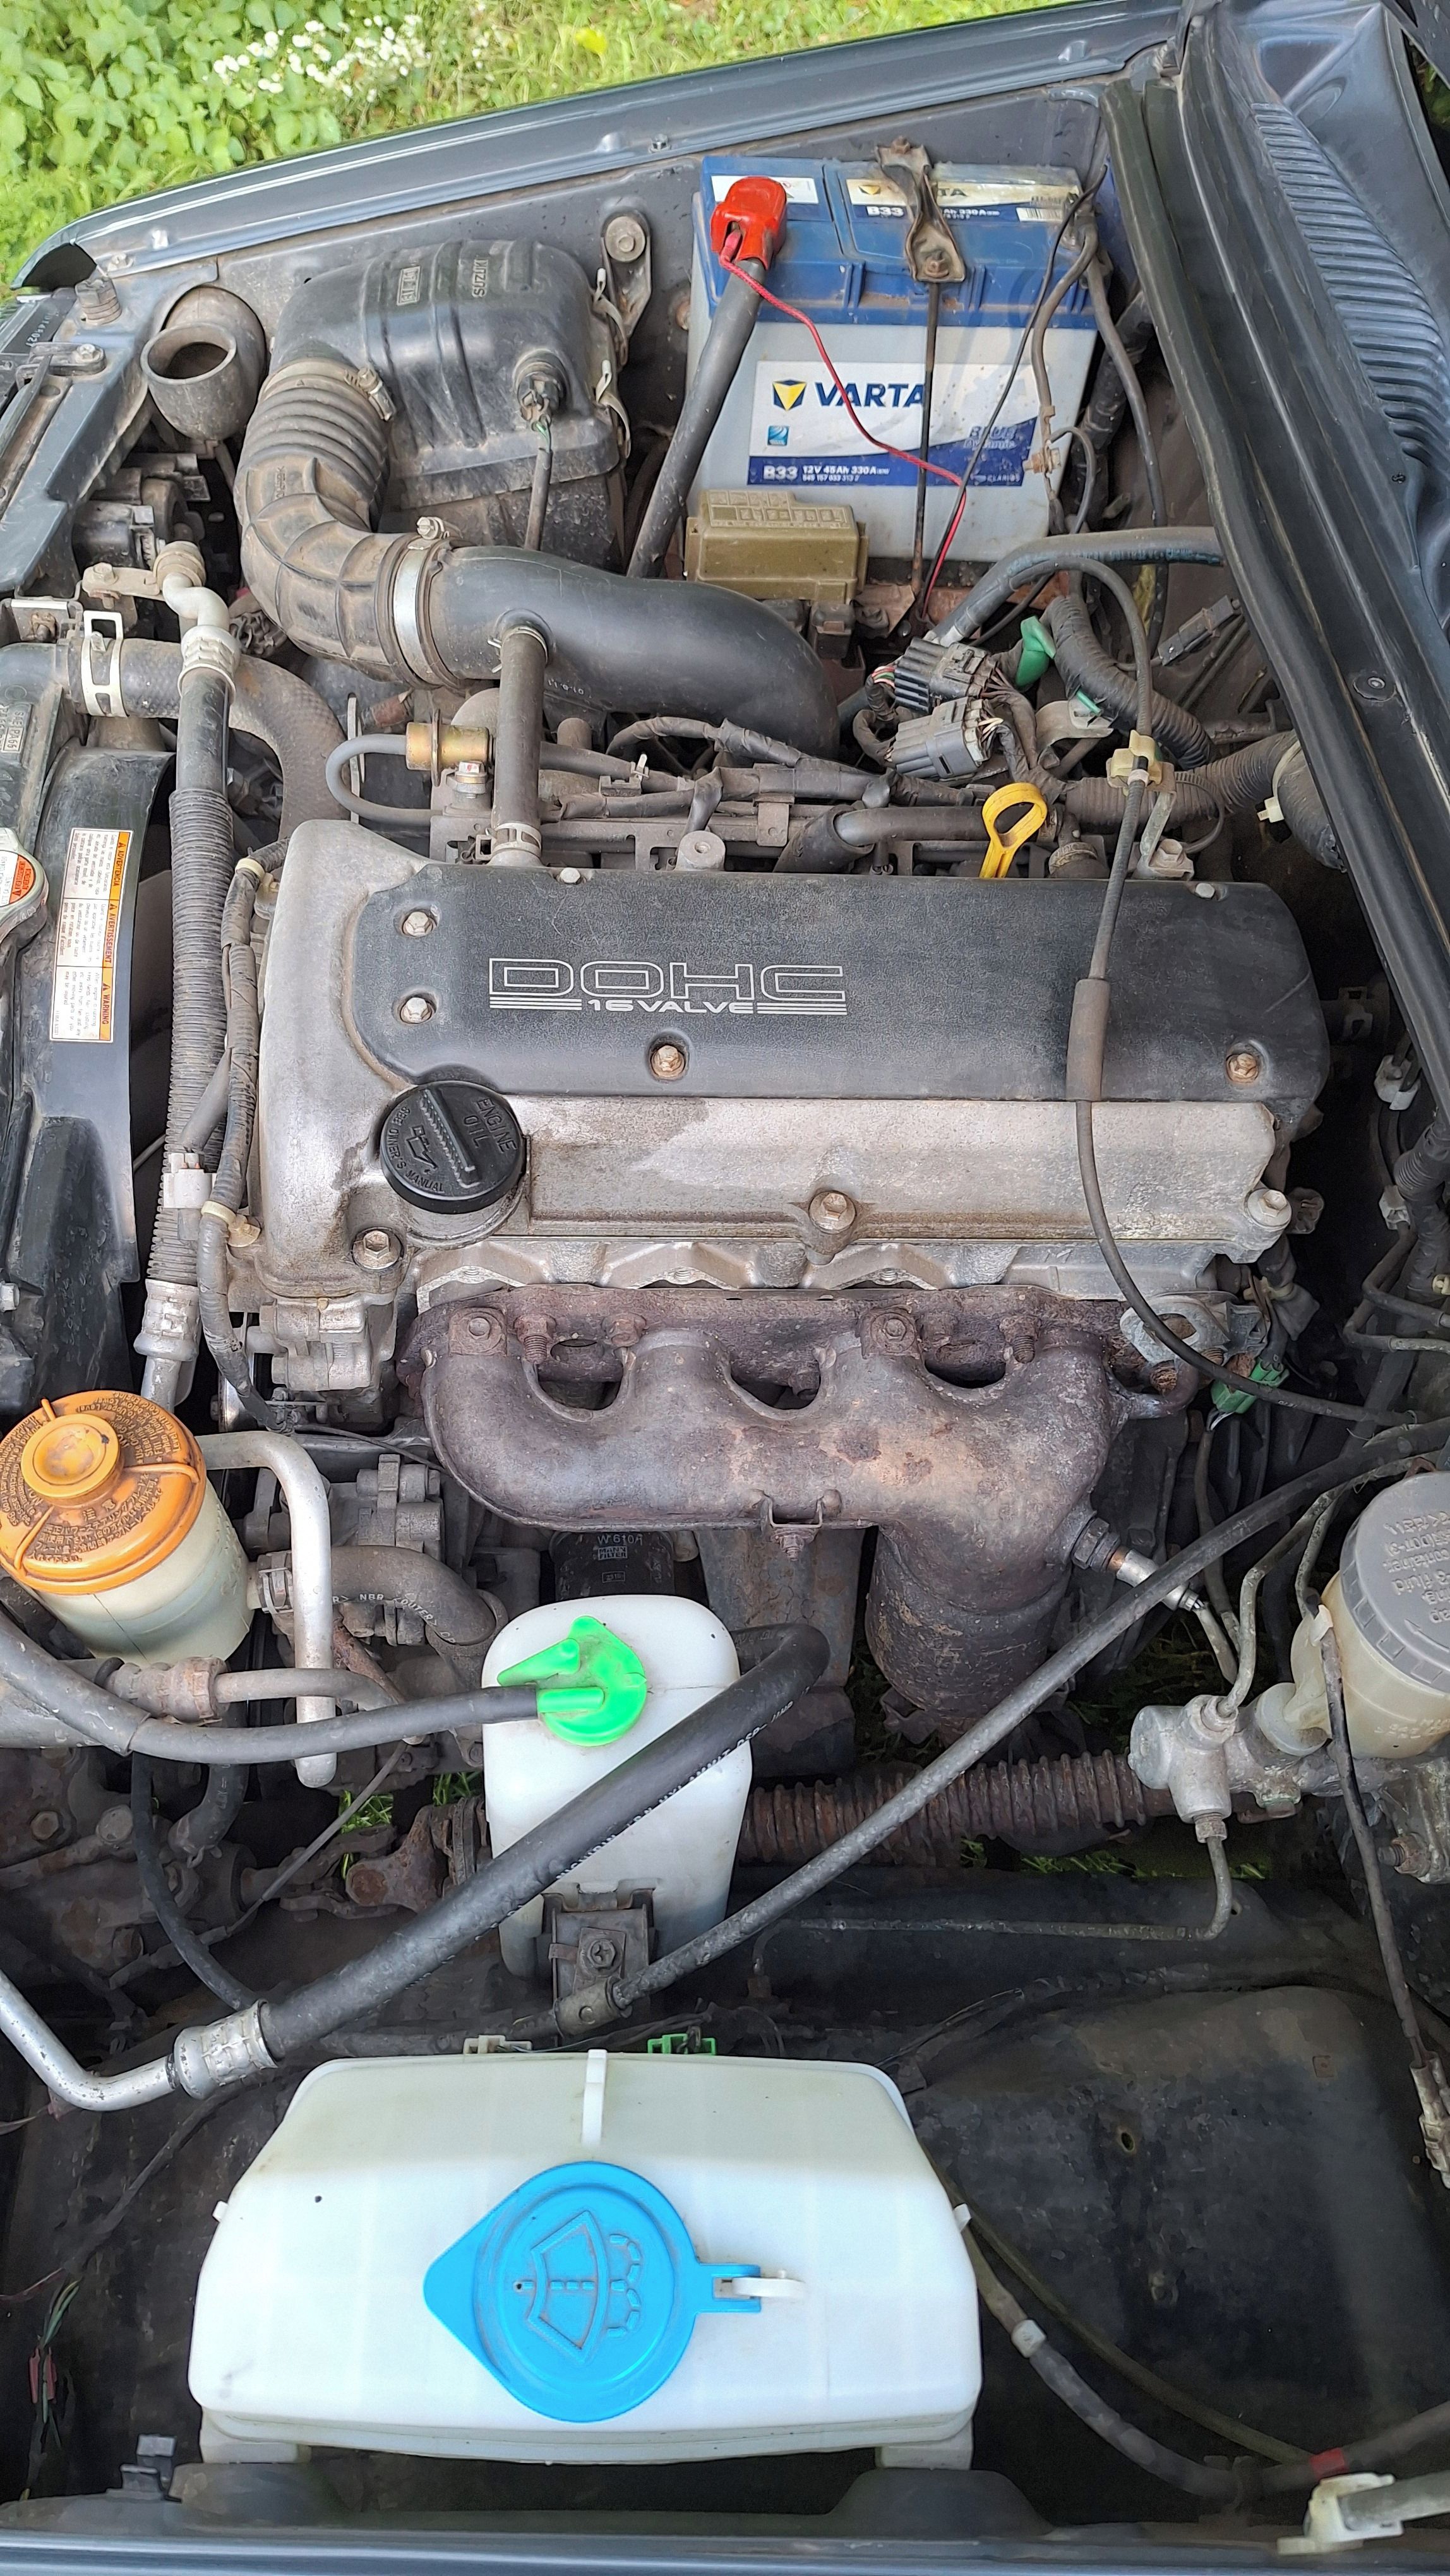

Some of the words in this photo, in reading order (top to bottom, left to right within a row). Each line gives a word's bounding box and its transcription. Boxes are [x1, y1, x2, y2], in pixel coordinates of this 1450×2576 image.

[472, 259, 488, 297] SUZUKI
[815, 382, 925, 407] VARTA
[763, 465, 798, 480] B33
[803, 465, 822, 474] 12V
[112, 850, 124, 886] ADVERTENCIA
[105, 912, 116, 963] AVERTISSEMENT
[489, 958, 845, 1002] DOHC
[102, 994, 111, 1025] WARNING
[464, 1114, 491, 1149] OIL
[476, 1097, 518, 1154] ENGINE
[387, 1128, 407, 1169] OWNER'S
[405, 1169, 445, 1194] MANUAL
[135, 1427, 153, 1457] Steering
[597, 1534, 609, 1546] W
[1391, 1572, 1432, 1596] fluid
